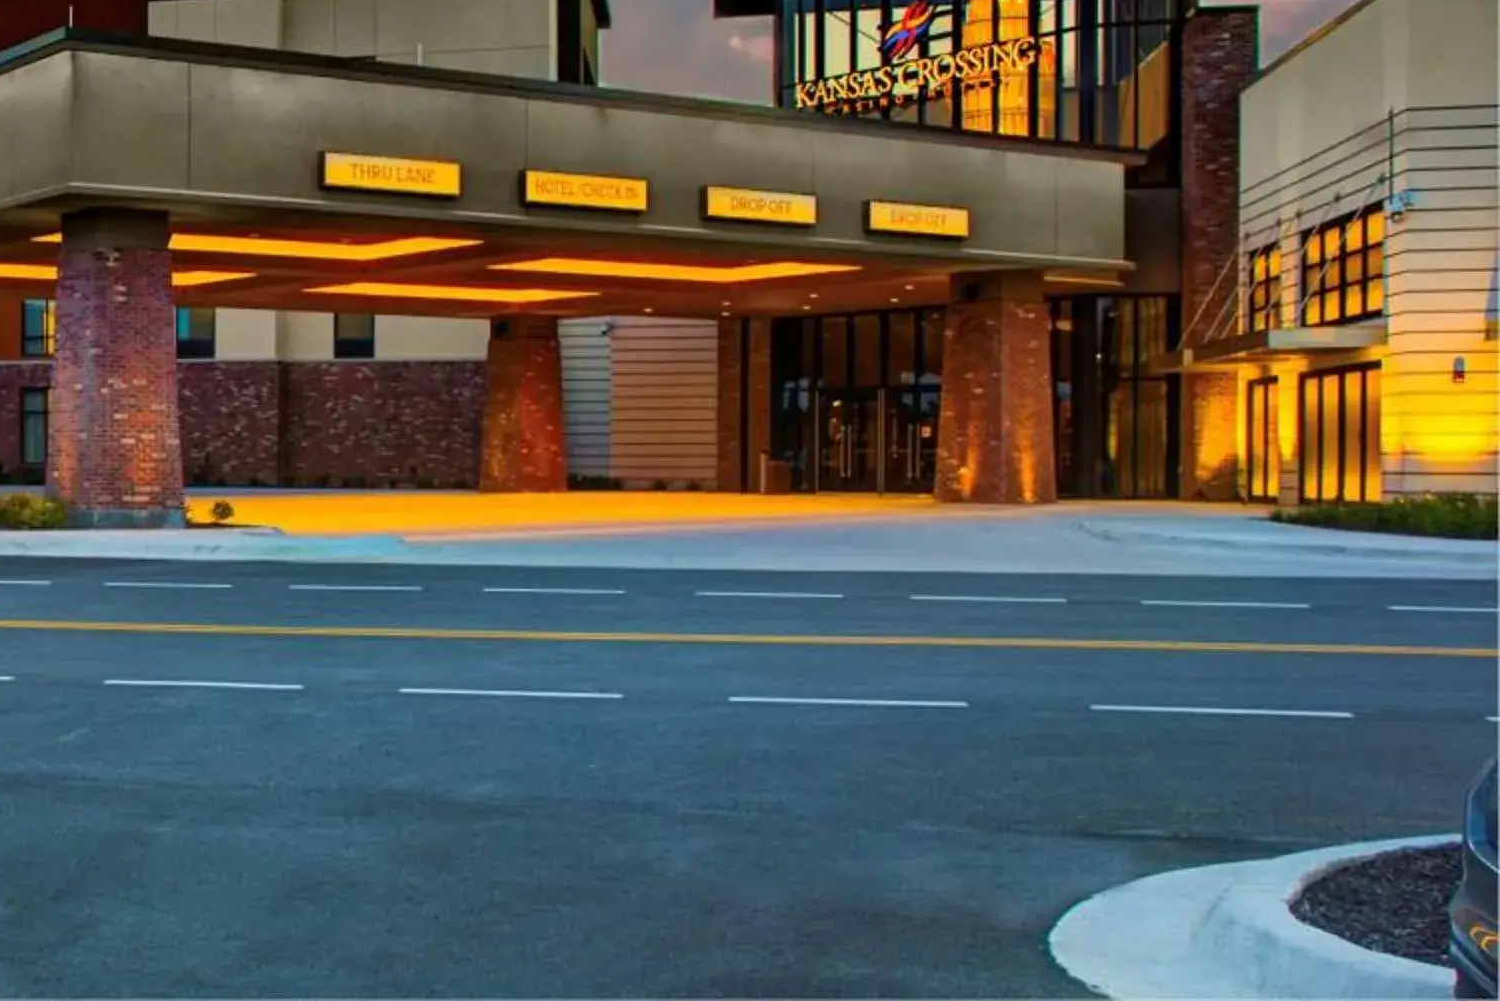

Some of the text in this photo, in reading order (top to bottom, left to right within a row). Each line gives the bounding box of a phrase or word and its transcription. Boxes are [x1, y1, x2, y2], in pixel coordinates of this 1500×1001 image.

[795, 65, 893, 108] KANSAS
[897, 37, 1035, 89] CROSSING
[348, 162, 438, 184] THRU LANE
[534, 177, 576, 198] HOTEL
[581, 183, 622, 200] CHECK
[730, 195, 792, 216] DROP OFF
